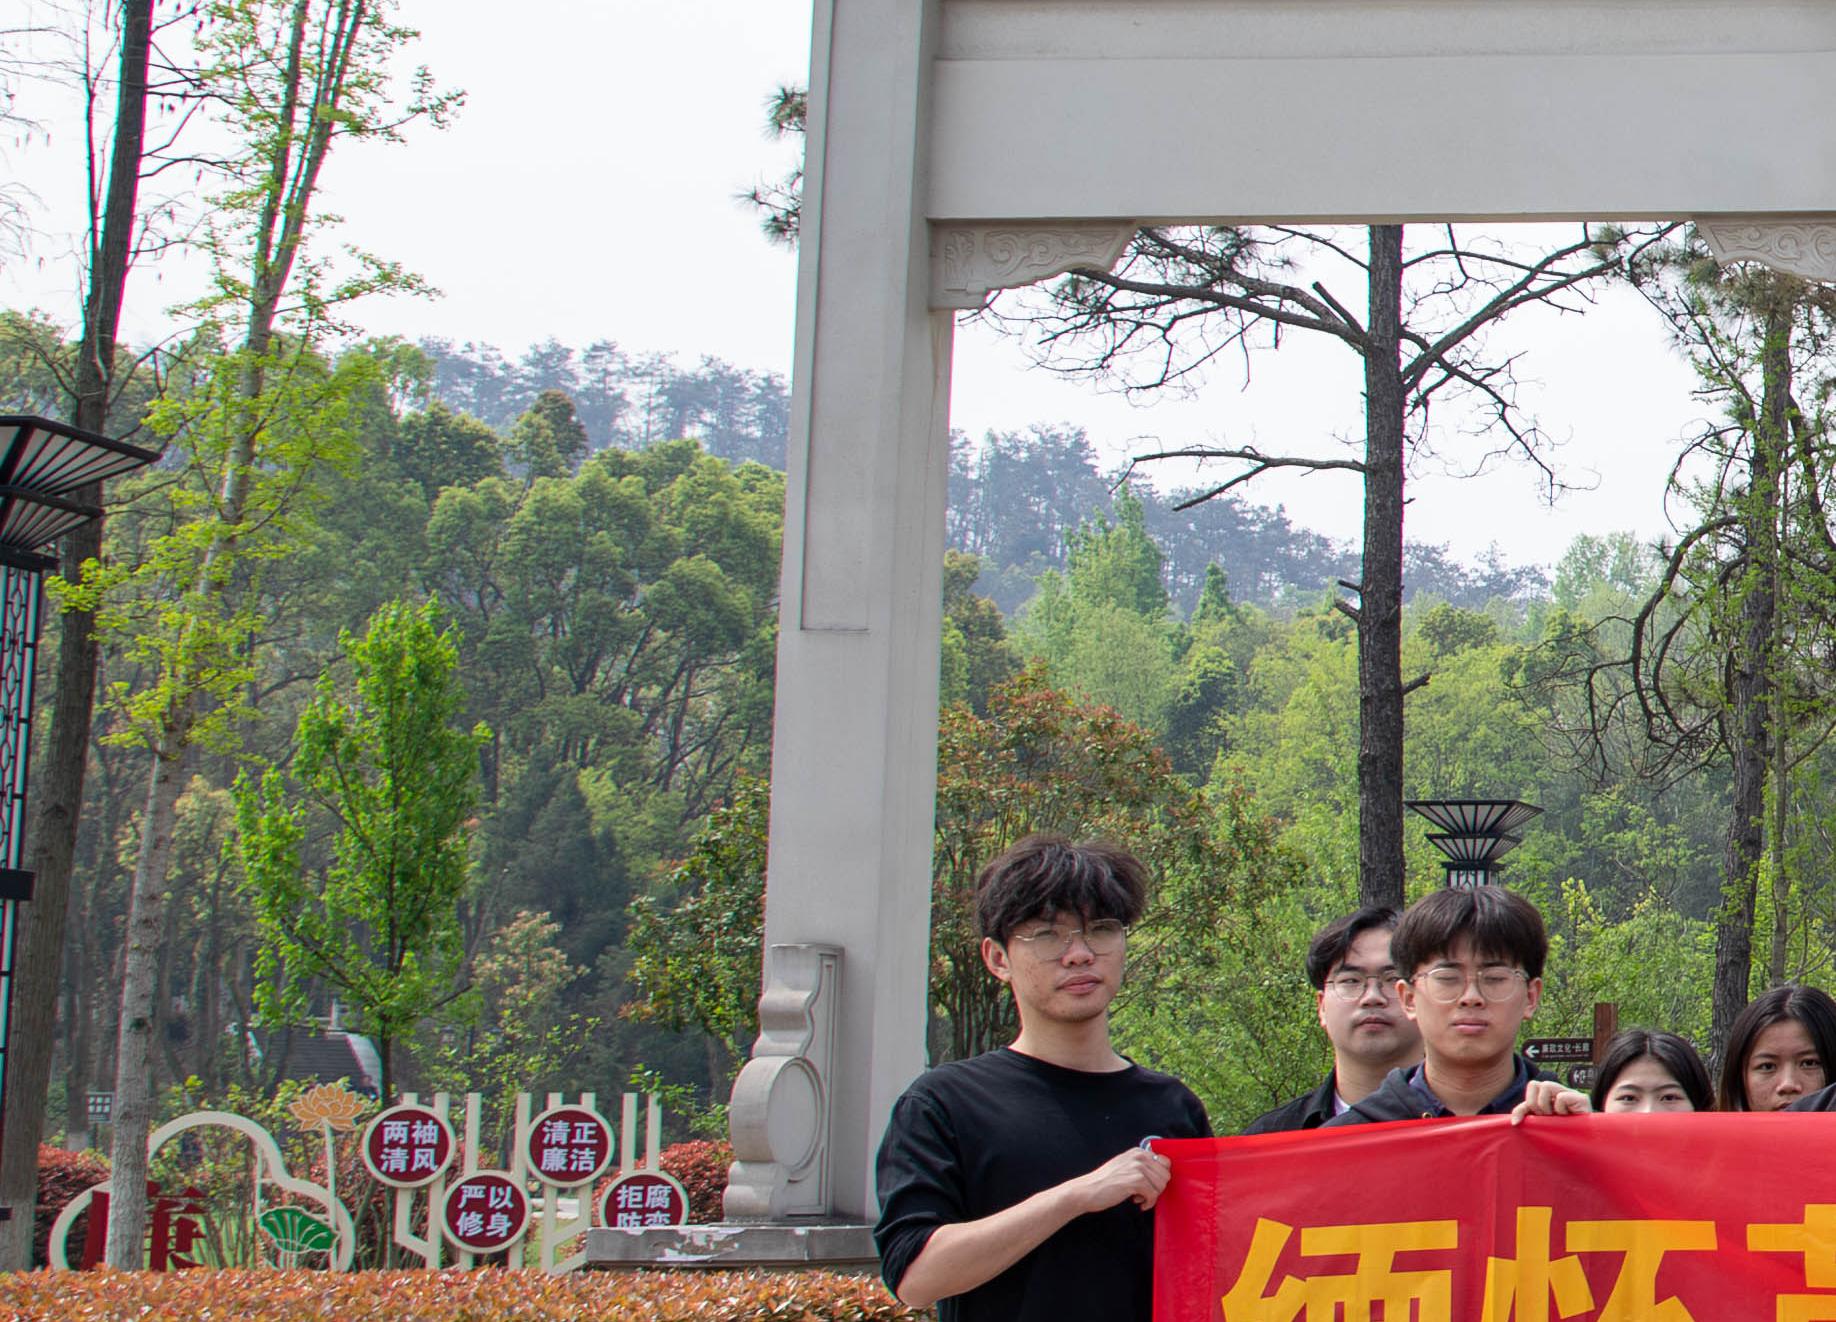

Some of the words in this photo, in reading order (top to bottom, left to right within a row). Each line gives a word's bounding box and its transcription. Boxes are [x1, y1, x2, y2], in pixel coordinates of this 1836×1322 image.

[383, 1120, 438, 1144] 两袖
[542, 1120, 598, 1145] 清正
[380, 1147, 438, 1172] 清风
[541, 1147, 596, 1171] 廉洁
[457, 1185, 513, 1209] 严以
[616, 1184, 672, 1209] 拒腐
[456, 1211, 512, 1237] 修身
